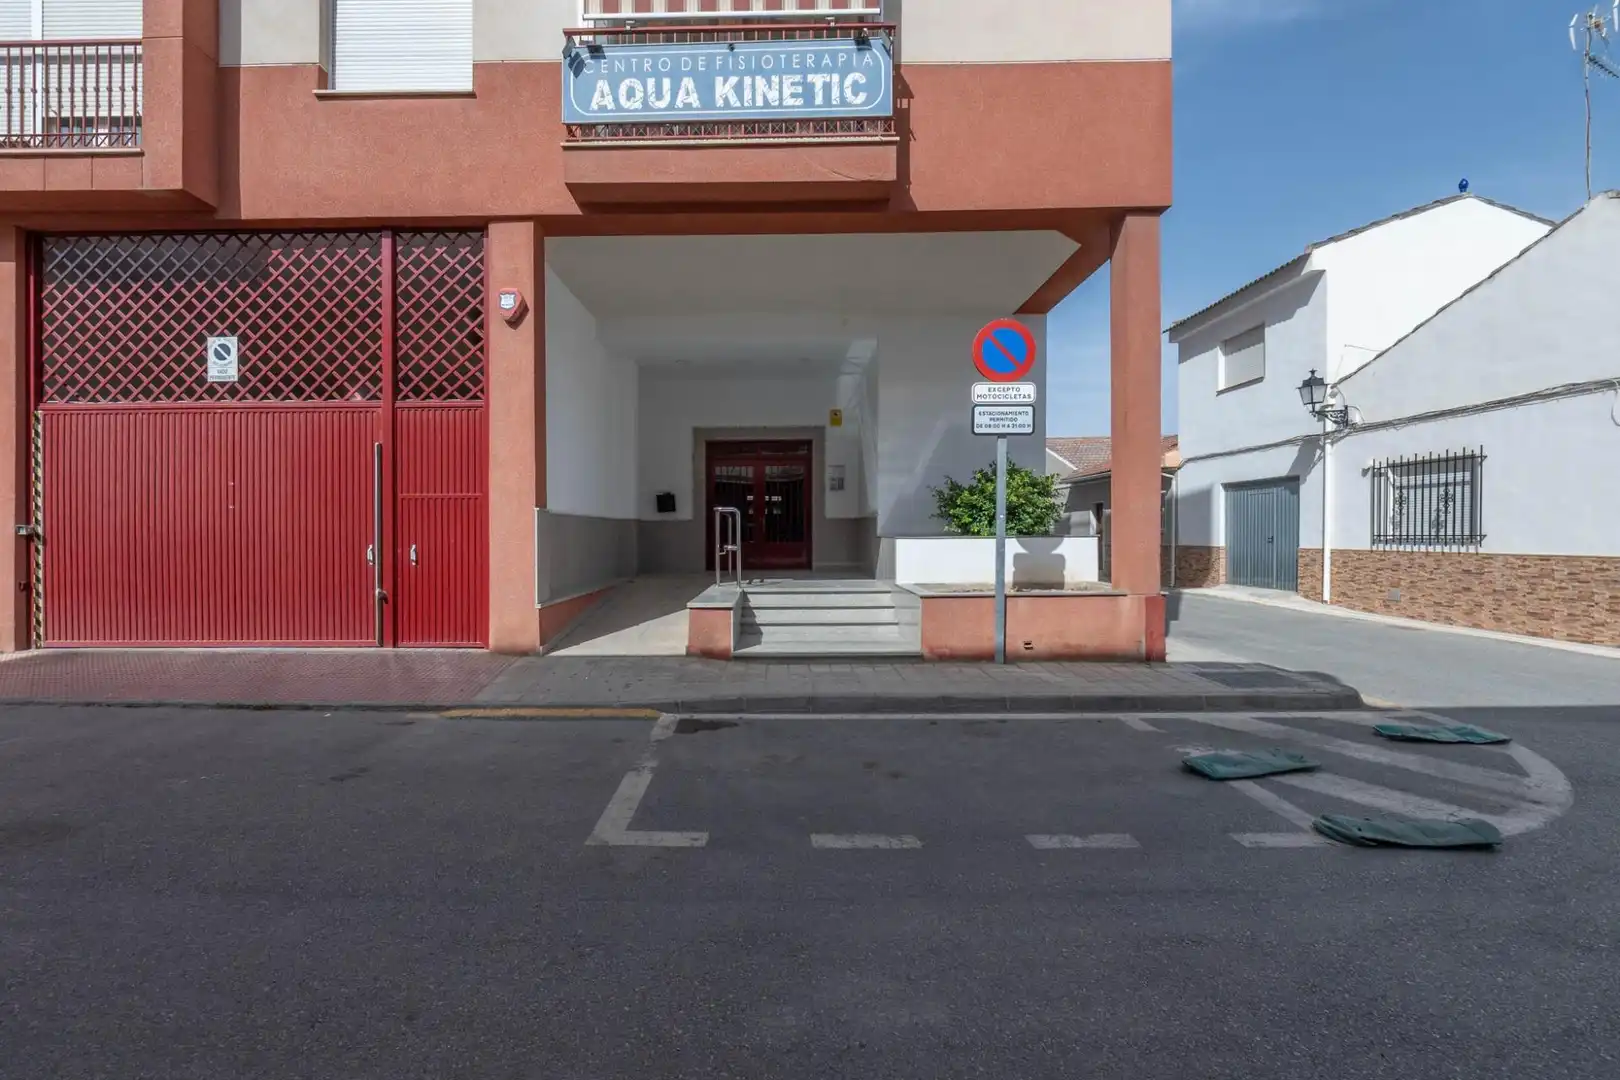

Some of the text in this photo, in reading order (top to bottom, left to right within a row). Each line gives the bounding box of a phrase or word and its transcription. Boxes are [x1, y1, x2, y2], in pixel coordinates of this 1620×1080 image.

[583, 51, 874, 74] CENTRO DE FISIOTERAPIA
[588, 72, 868, 112] AQUA KINETIC
